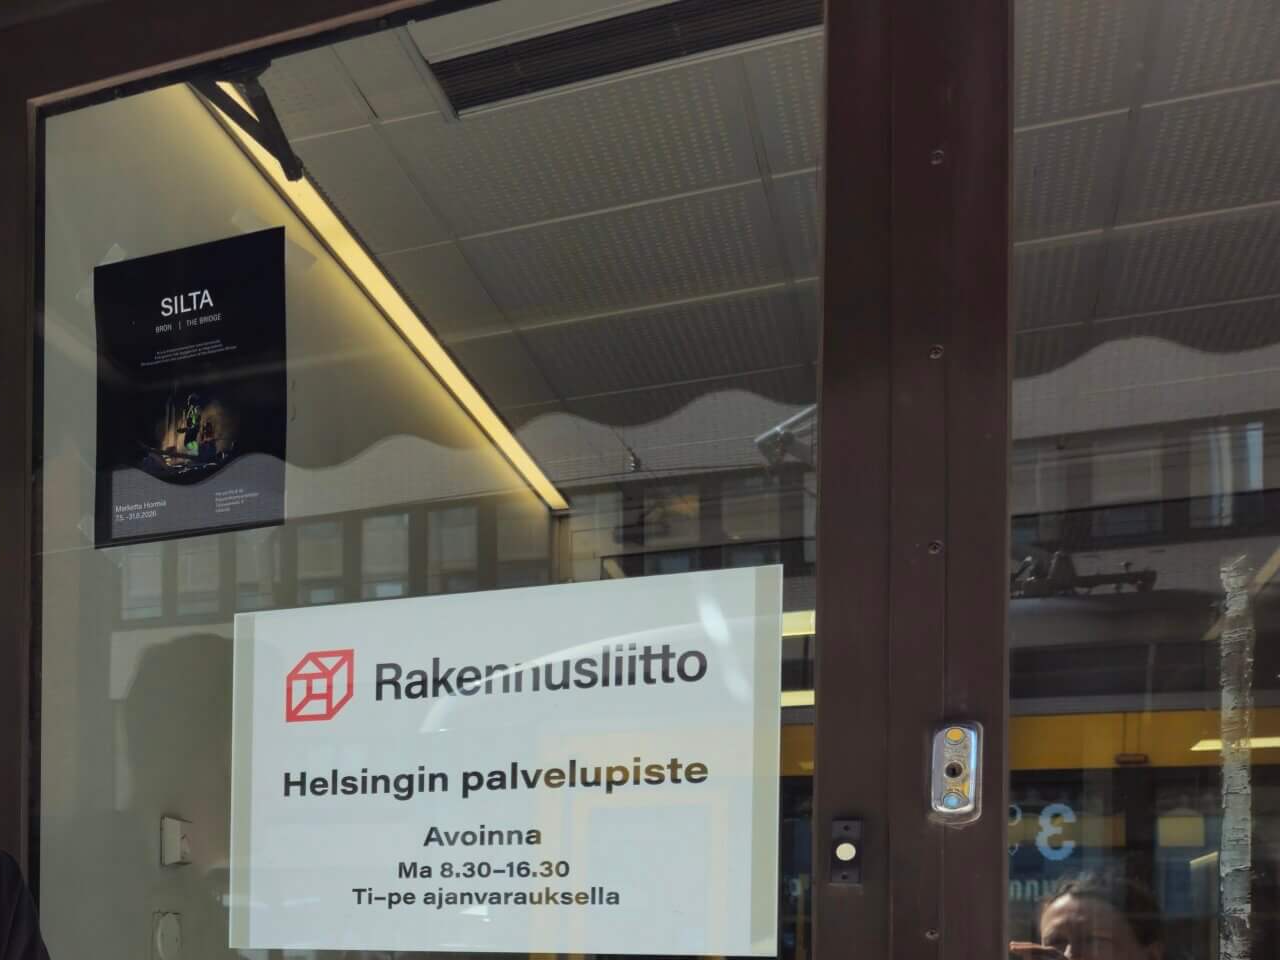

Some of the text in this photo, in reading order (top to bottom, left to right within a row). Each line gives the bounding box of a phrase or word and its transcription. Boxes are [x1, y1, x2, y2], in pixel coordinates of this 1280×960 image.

[160, 288, 214, 317] SILTA
[186, 317, 198, 327] THE
[199, 312, 222, 325] BRIDGE
[374, 643, 709, 702] Rakennusliitto
[282, 756, 709, 801] Helsingin palvelupiste
[422, 824, 543, 848] Avoinna
[396, 861, 433, 880] Ma
[422, 885, 622, 911] ajanvarauksella
